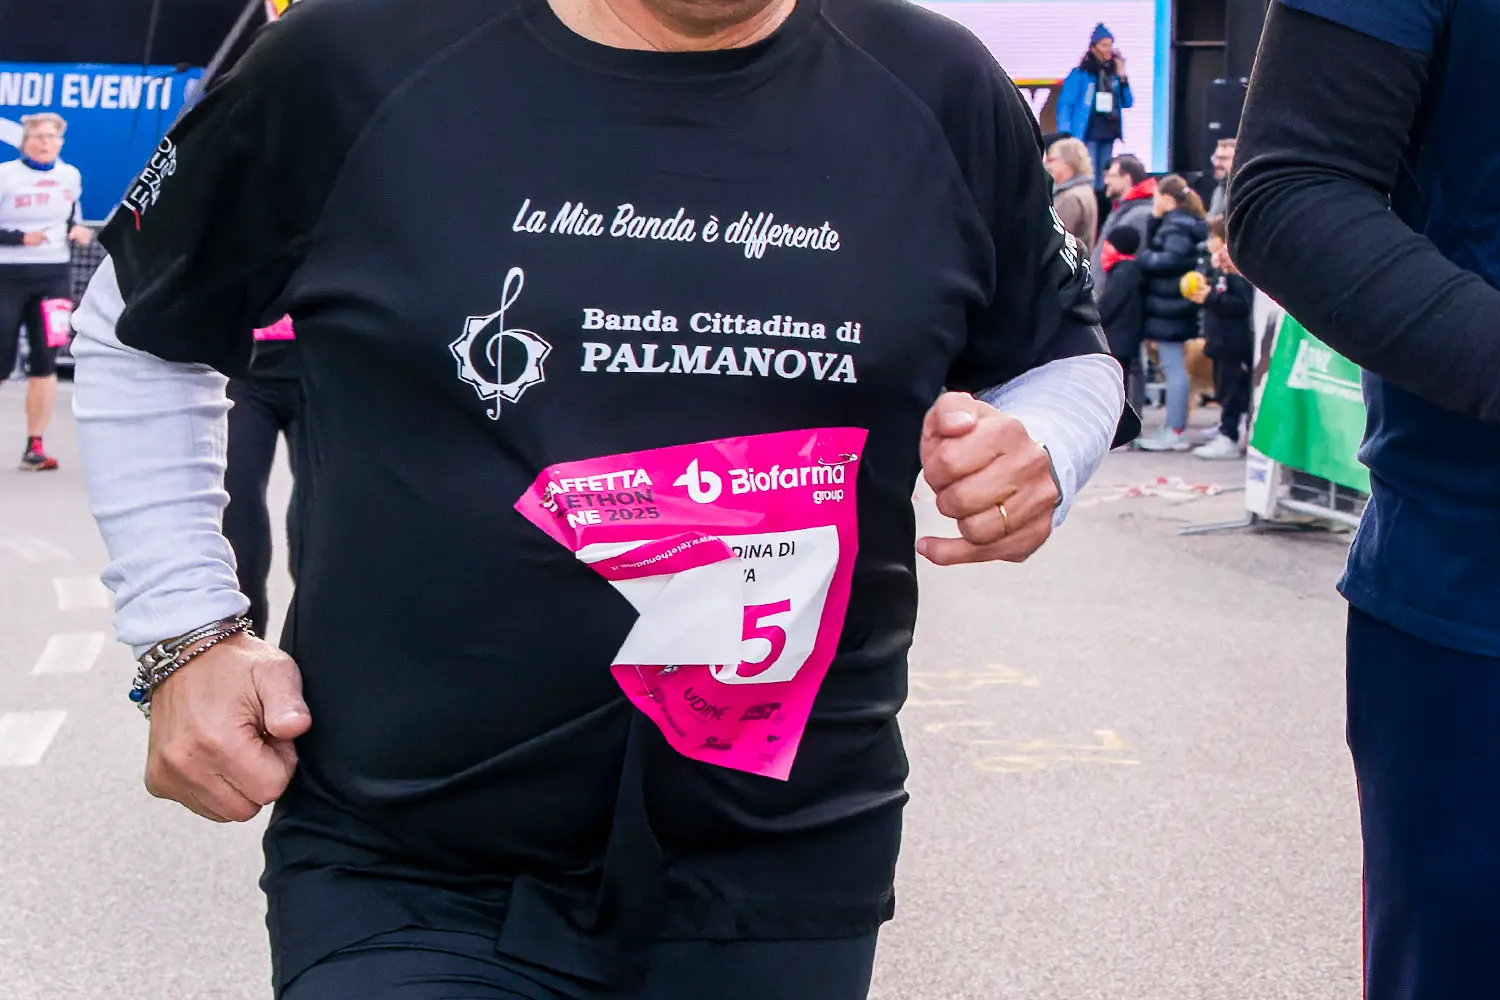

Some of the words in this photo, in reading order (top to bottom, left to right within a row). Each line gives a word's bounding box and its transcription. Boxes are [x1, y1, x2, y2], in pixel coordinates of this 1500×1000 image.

[61, 74, 172, 110] EVENTI
[512, 199, 547, 233] La
[550, 202, 604, 237] Mia
[610, 203, 695, 242] Banda
[703, 215, 719, 243] è
[725, 211, 840, 259] differente
[582, 308, 678, 333] Banda
[690, 312, 826, 339] Cittadina
[836, 322, 862, 344] di
[581, 342, 857, 383] PALMANOVA
[728, 463, 845, 495] Biofarma
[813, 489, 844, 505] group
[605, 507, 660, 521] 2025
[779, 541, 795, 557] DI
[736, 599, 790, 678] 5
